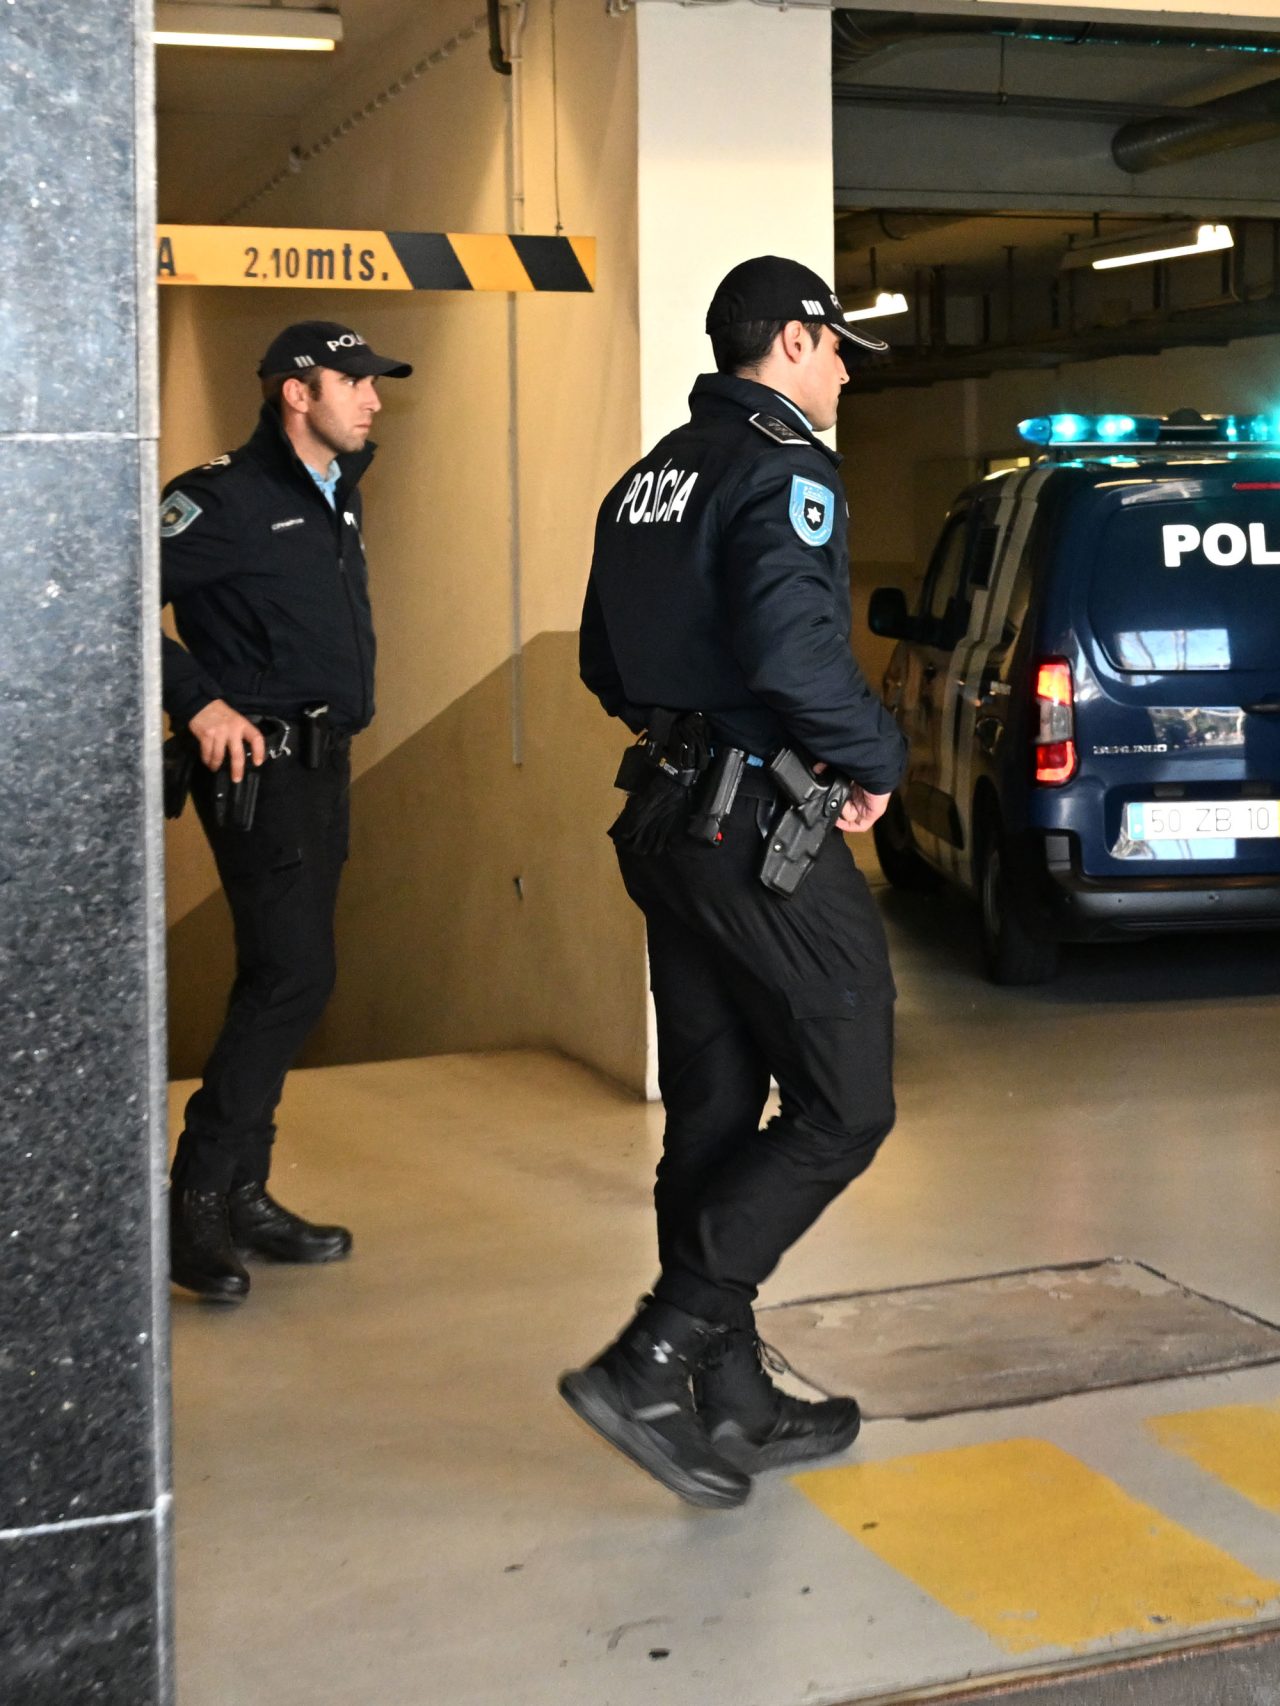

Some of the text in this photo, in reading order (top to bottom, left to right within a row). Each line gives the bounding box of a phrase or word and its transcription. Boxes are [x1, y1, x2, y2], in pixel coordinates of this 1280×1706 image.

[1151, 808, 1182, 833] 50
[1195, 807, 1232, 832] ZB
[1247, 806, 1270, 831] 10
